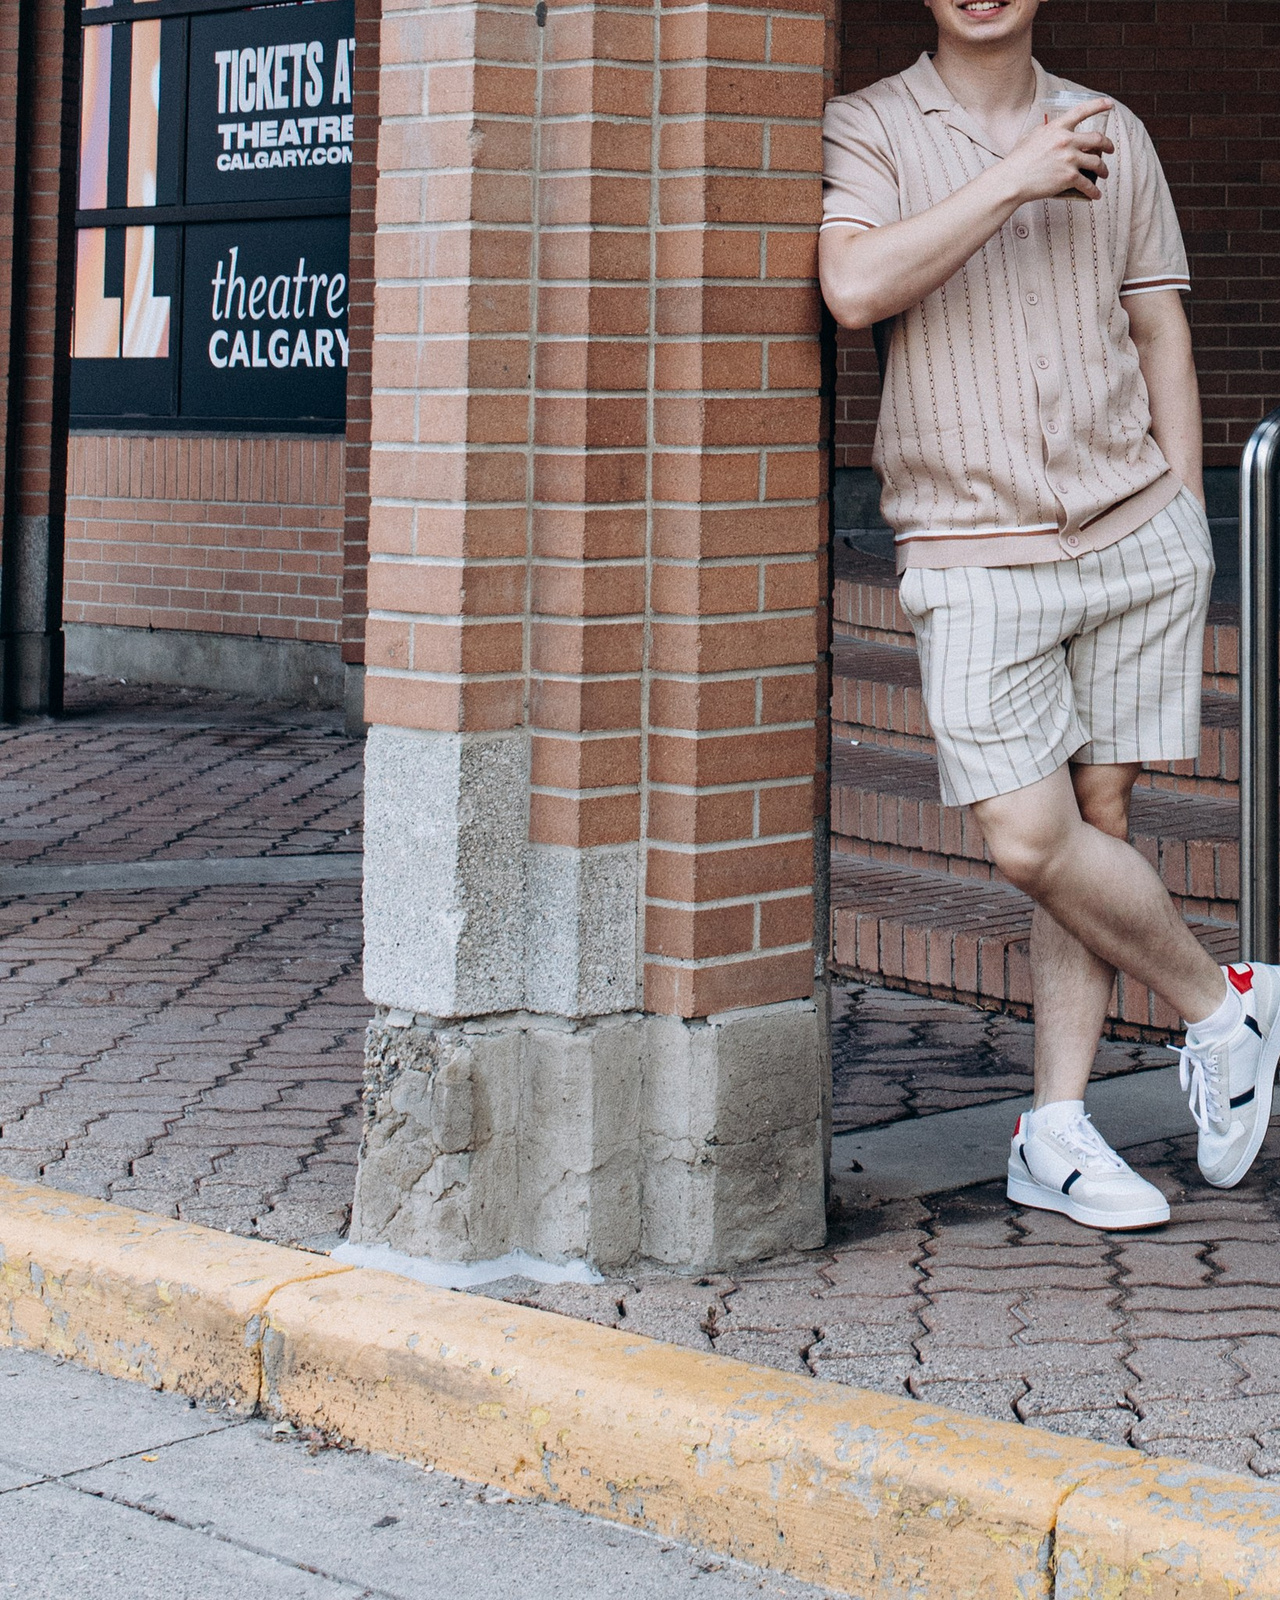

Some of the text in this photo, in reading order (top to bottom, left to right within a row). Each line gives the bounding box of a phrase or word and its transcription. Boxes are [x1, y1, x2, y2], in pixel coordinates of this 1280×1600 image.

[215, 41, 324, 114] TICKETS
[217, 114, 355, 150] THEATRE
[211, 246, 350, 321] theatre
[208, 328, 350, 369] CALGARY
